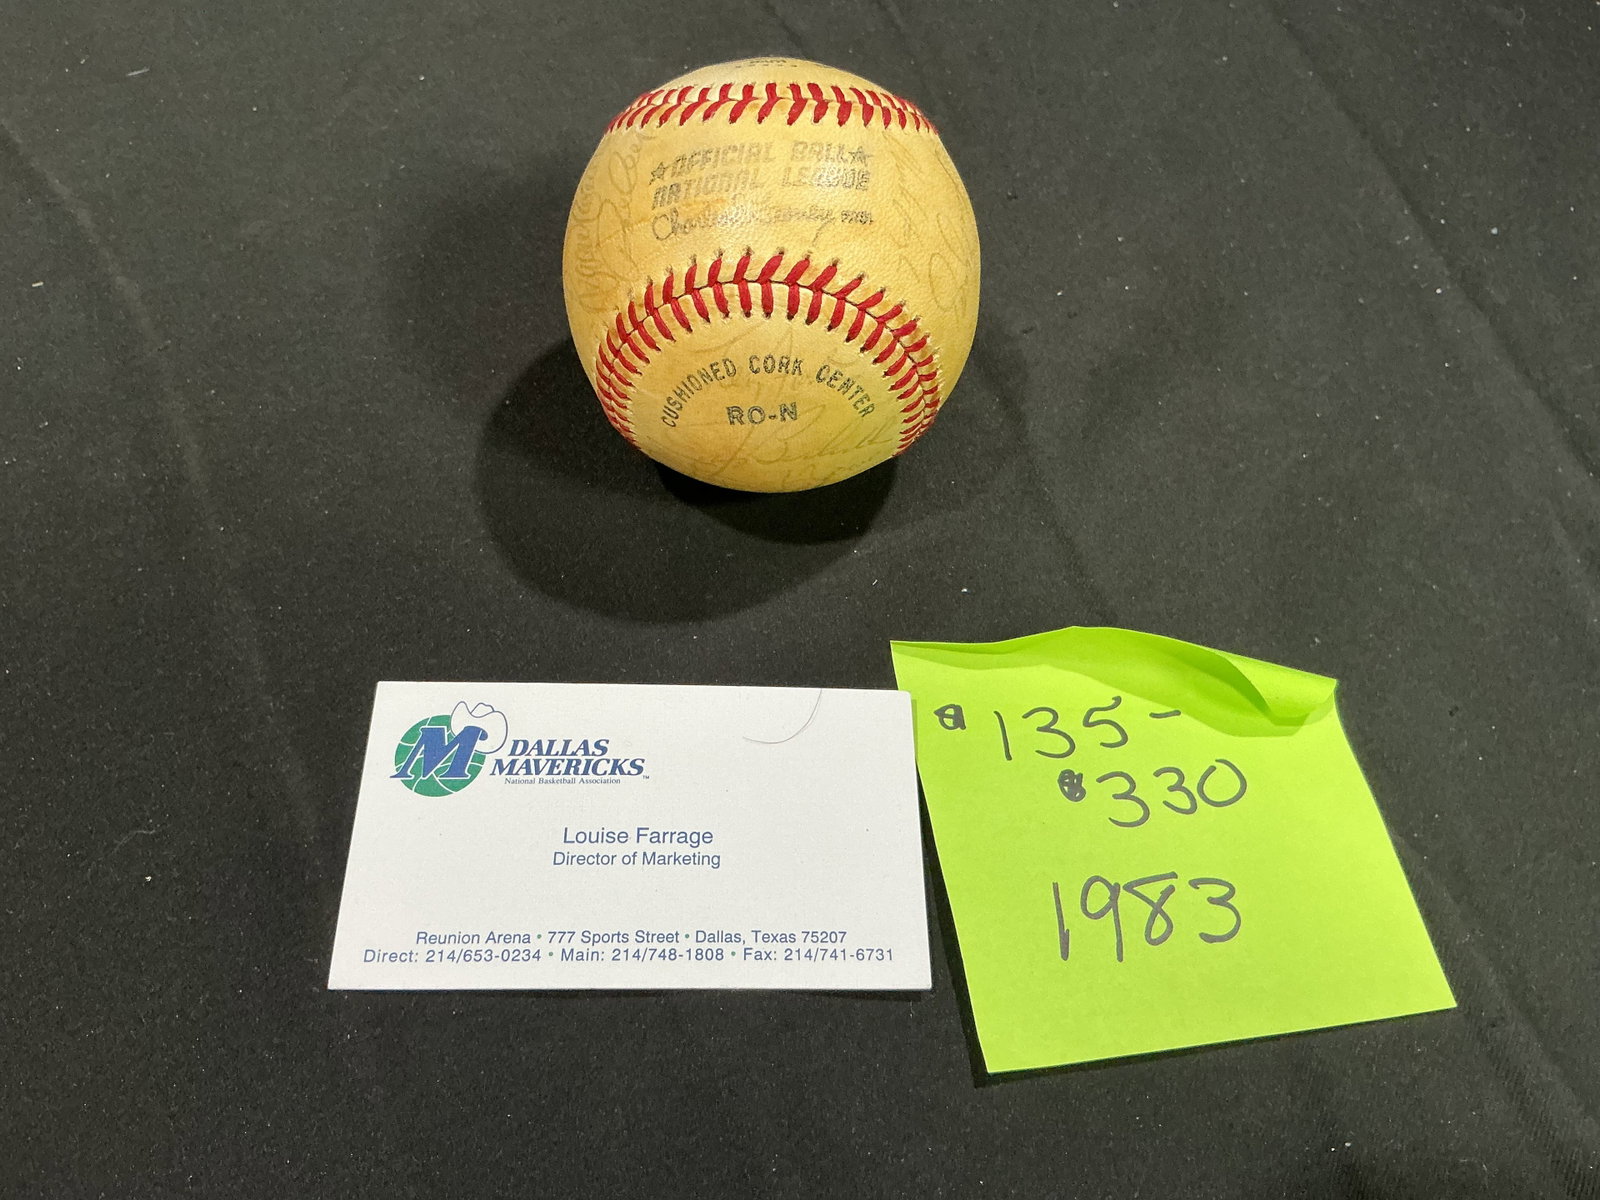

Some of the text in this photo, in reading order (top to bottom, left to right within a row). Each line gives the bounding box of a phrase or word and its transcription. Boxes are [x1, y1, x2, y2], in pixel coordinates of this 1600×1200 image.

[671, 140, 849, 177] OFFICIAL BALL
[652, 168, 765, 210] NATIONAL
[662, 354, 876, 428] CUSHIONED CORK CENTER
[726, 402, 798, 426] RO-N
[508, 739, 610, 757] DALLAS
[489, 758, 646, 776] MAVERICKS
[504, 777, 621, 785] National Basketball Association
[564, 827, 714, 848] Louise Farrage
[553, 851, 721, 869] Director of Marketing
[1052, 871, 1242, 962] 1983
[416, 929, 847, 947] Reunion Arena 777 Sports Street Dallas, Texas 75207
[363, 947, 892, 963] Direct: 214/653-0234 Main: 214/748-1808 Fax: 214/741-6731
